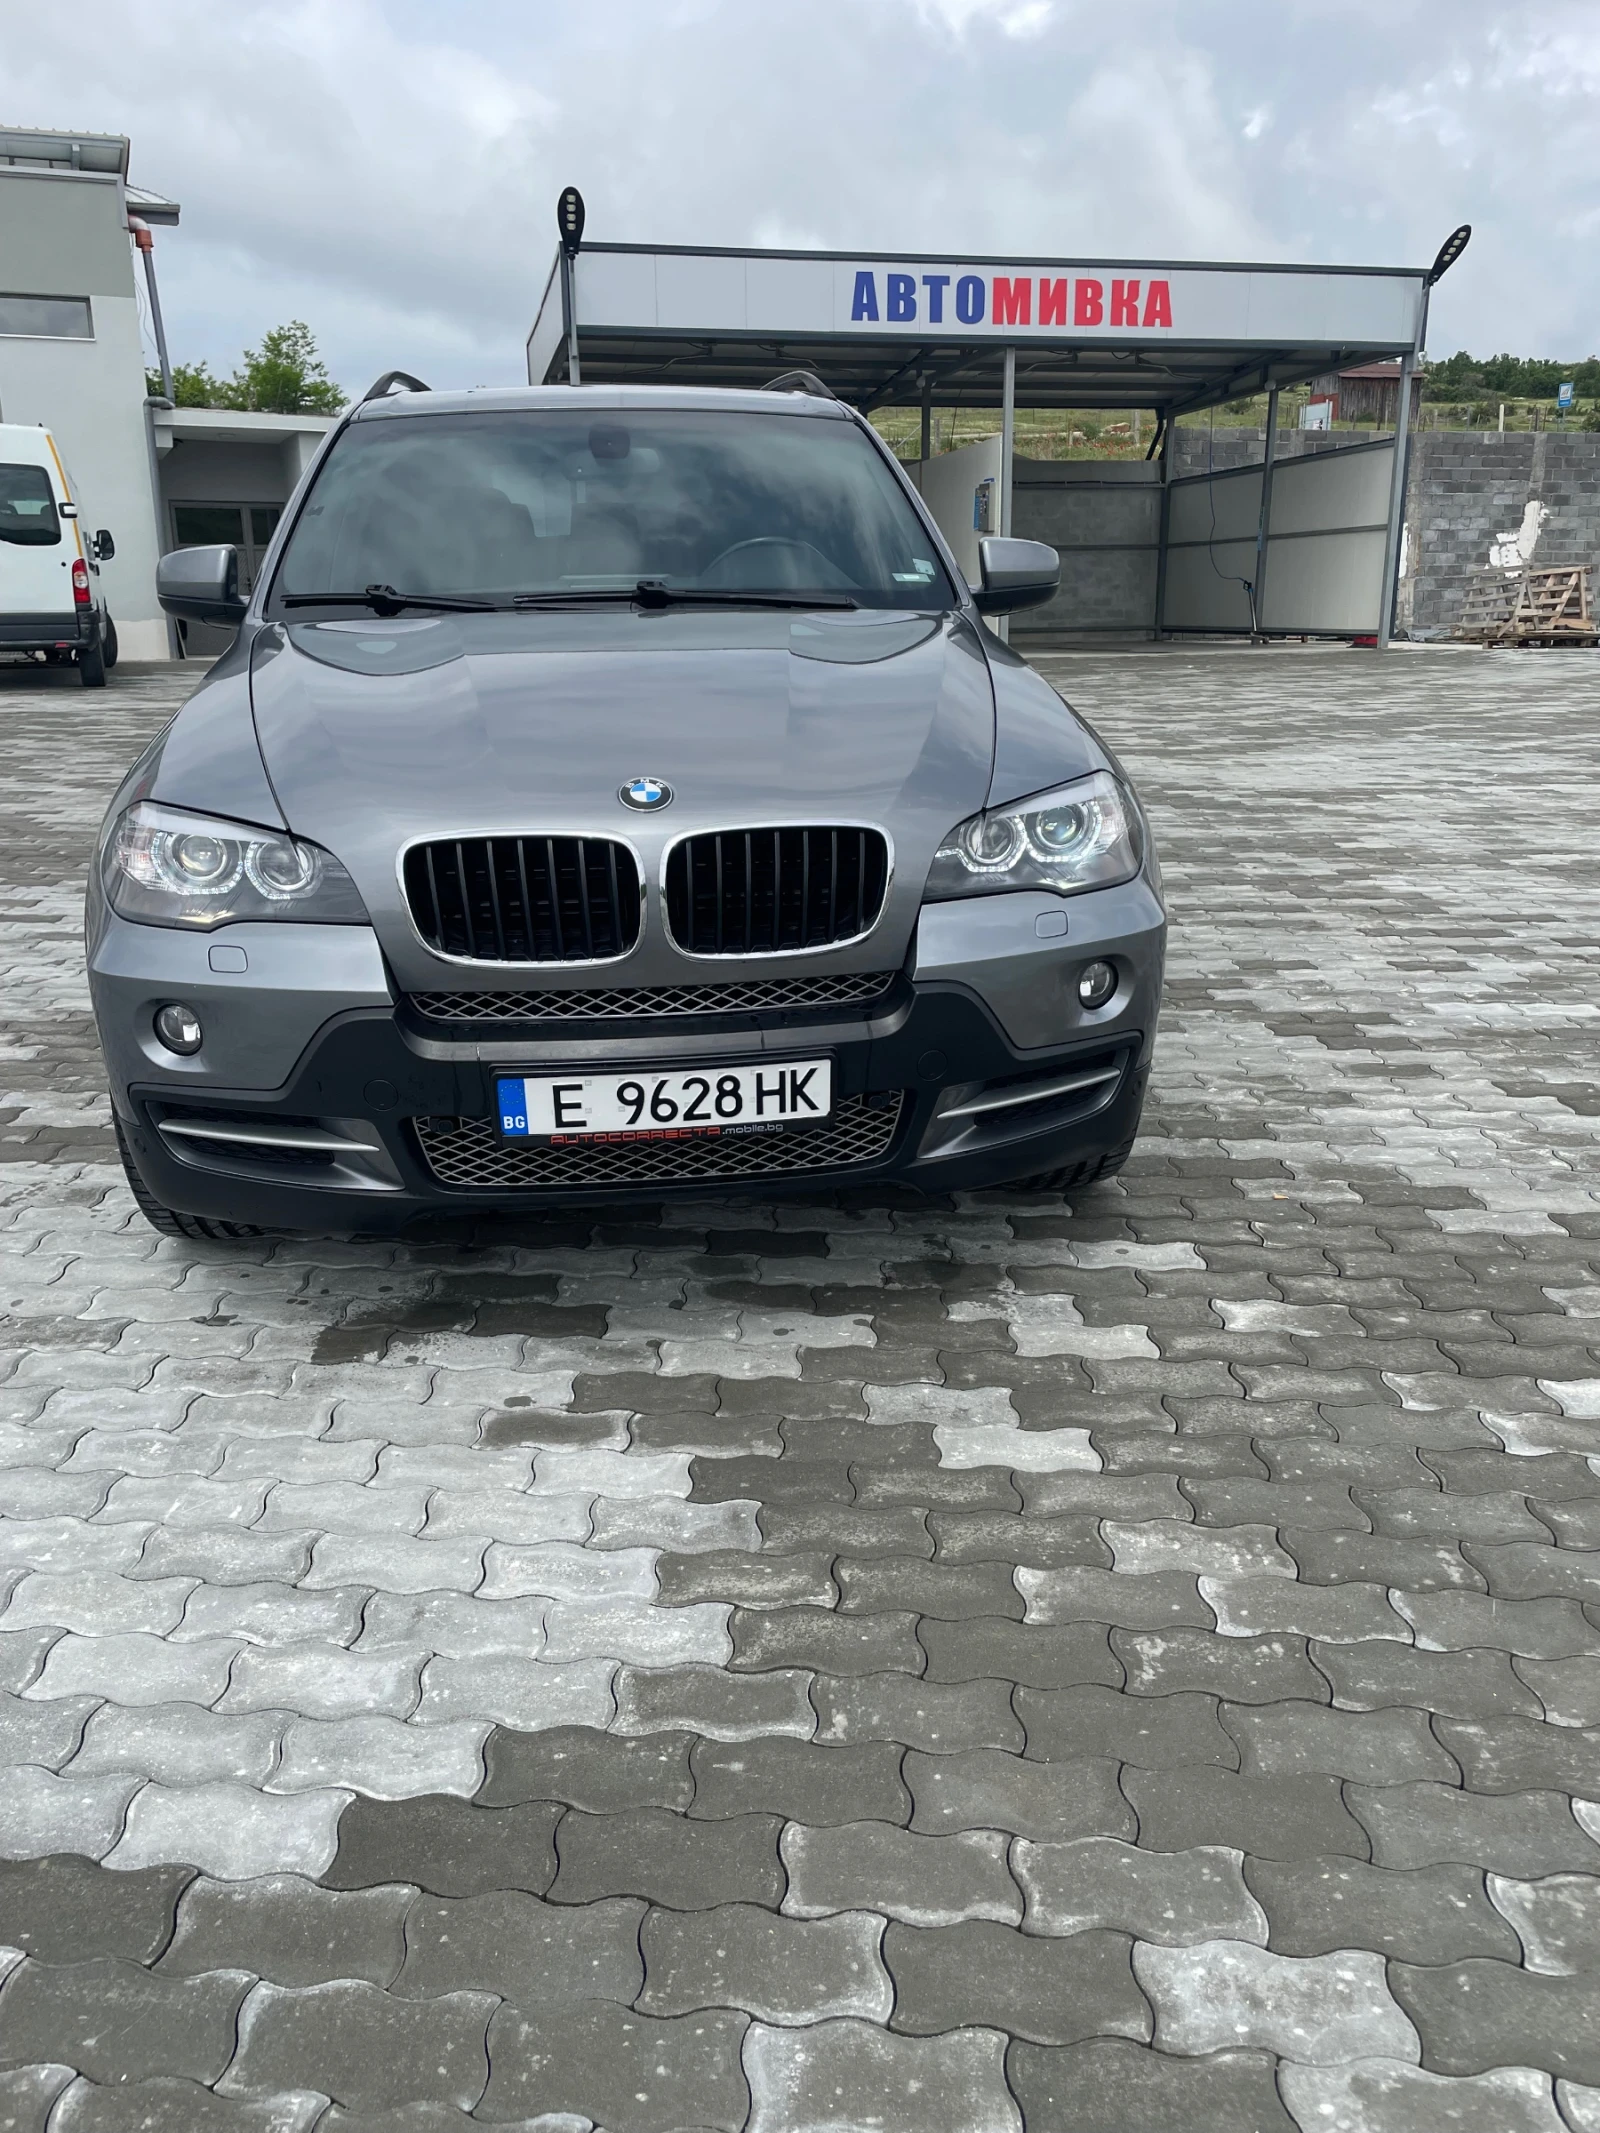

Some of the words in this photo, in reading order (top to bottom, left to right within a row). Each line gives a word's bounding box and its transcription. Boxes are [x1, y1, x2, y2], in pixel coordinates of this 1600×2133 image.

[851, 271, 1173, 328] АВТОМИВКА
[503, 1115, 526, 1130] BG
[552, 1083, 587, 1128] E
[616, 1074, 743, 1125] 9628
[755, 1067, 820, 1115] HK
